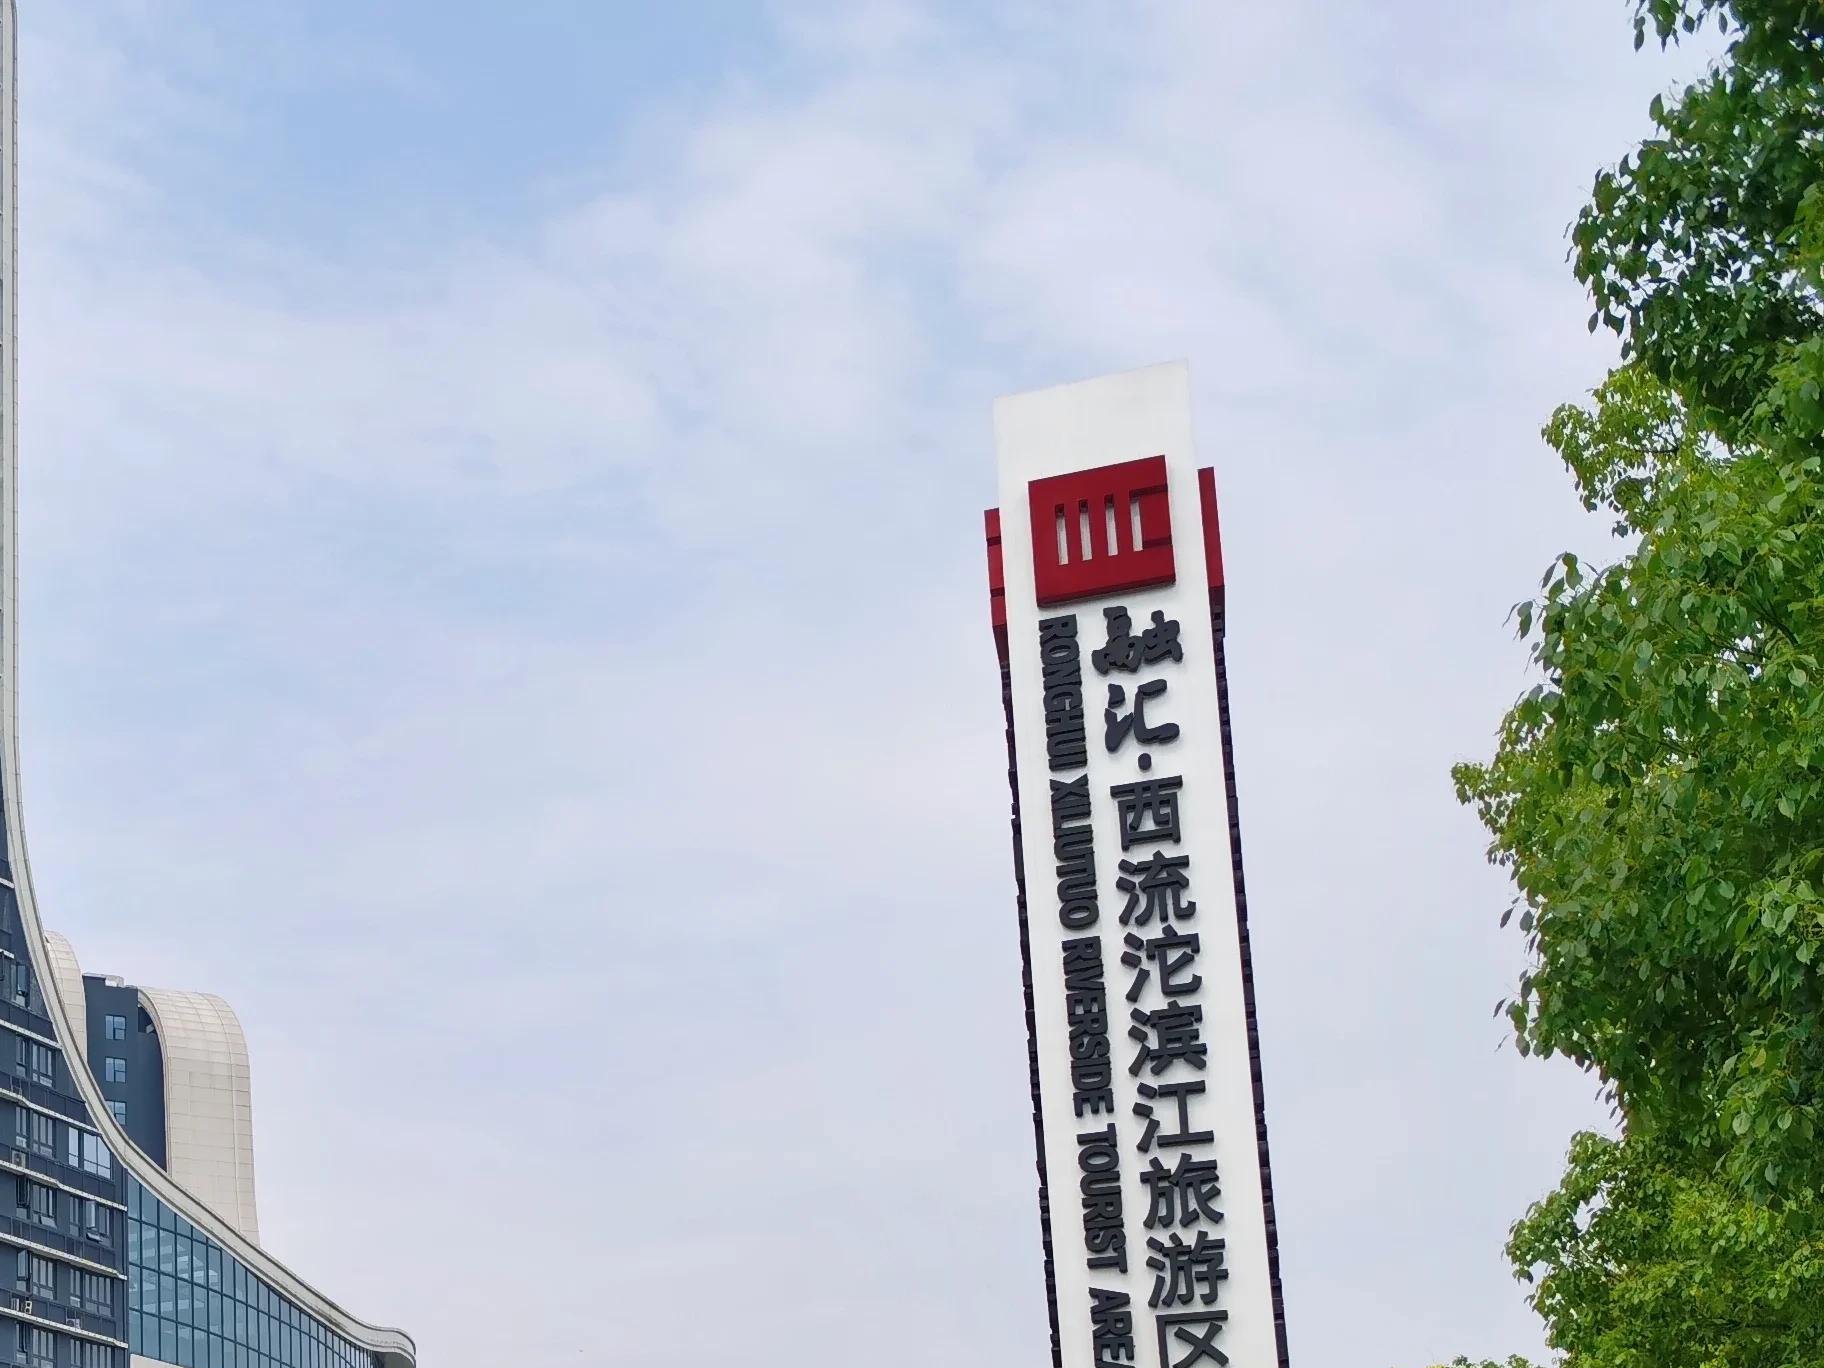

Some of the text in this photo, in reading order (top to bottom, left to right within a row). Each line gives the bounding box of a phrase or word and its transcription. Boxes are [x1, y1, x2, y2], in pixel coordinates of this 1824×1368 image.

[1038, 613, 1089, 772] RONGHUI
[1049, 773, 1099, 931] XILIUTUO
[1062, 935, 1114, 1118] RIVERSIDE
[1076, 1123, 1127, 1273] TOURIST
